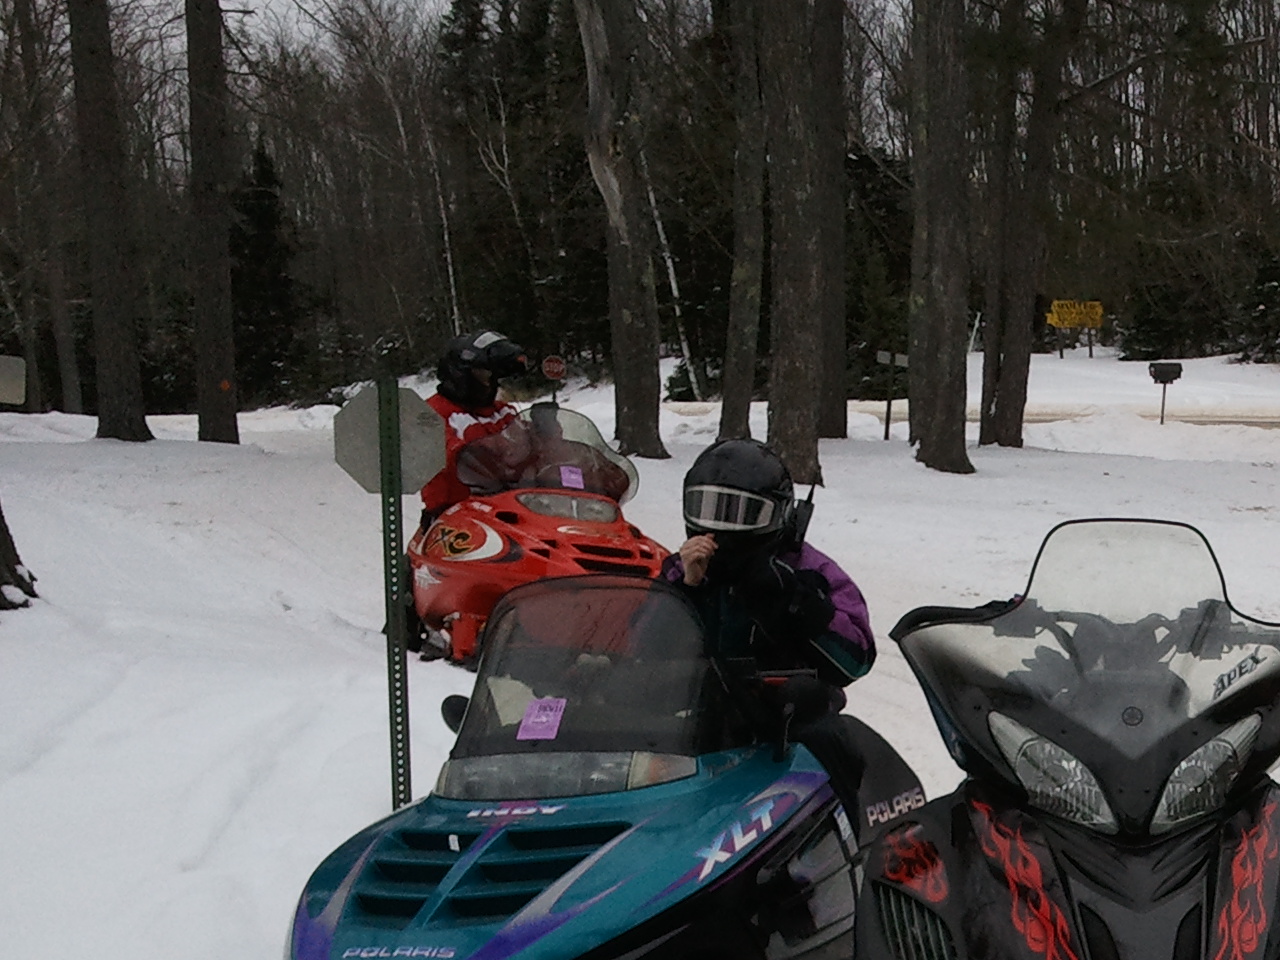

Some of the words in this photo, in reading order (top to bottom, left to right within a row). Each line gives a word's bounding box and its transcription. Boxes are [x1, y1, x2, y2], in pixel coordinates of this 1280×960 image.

[425, 526, 476, 557] XC
[1212, 645, 1268, 701] APEX
[466, 804, 568, 818] INDY
[866, 787, 926, 827] POLARIS
[695, 799, 774, 883] XLT
[342, 946, 457, 959] POLARIS
